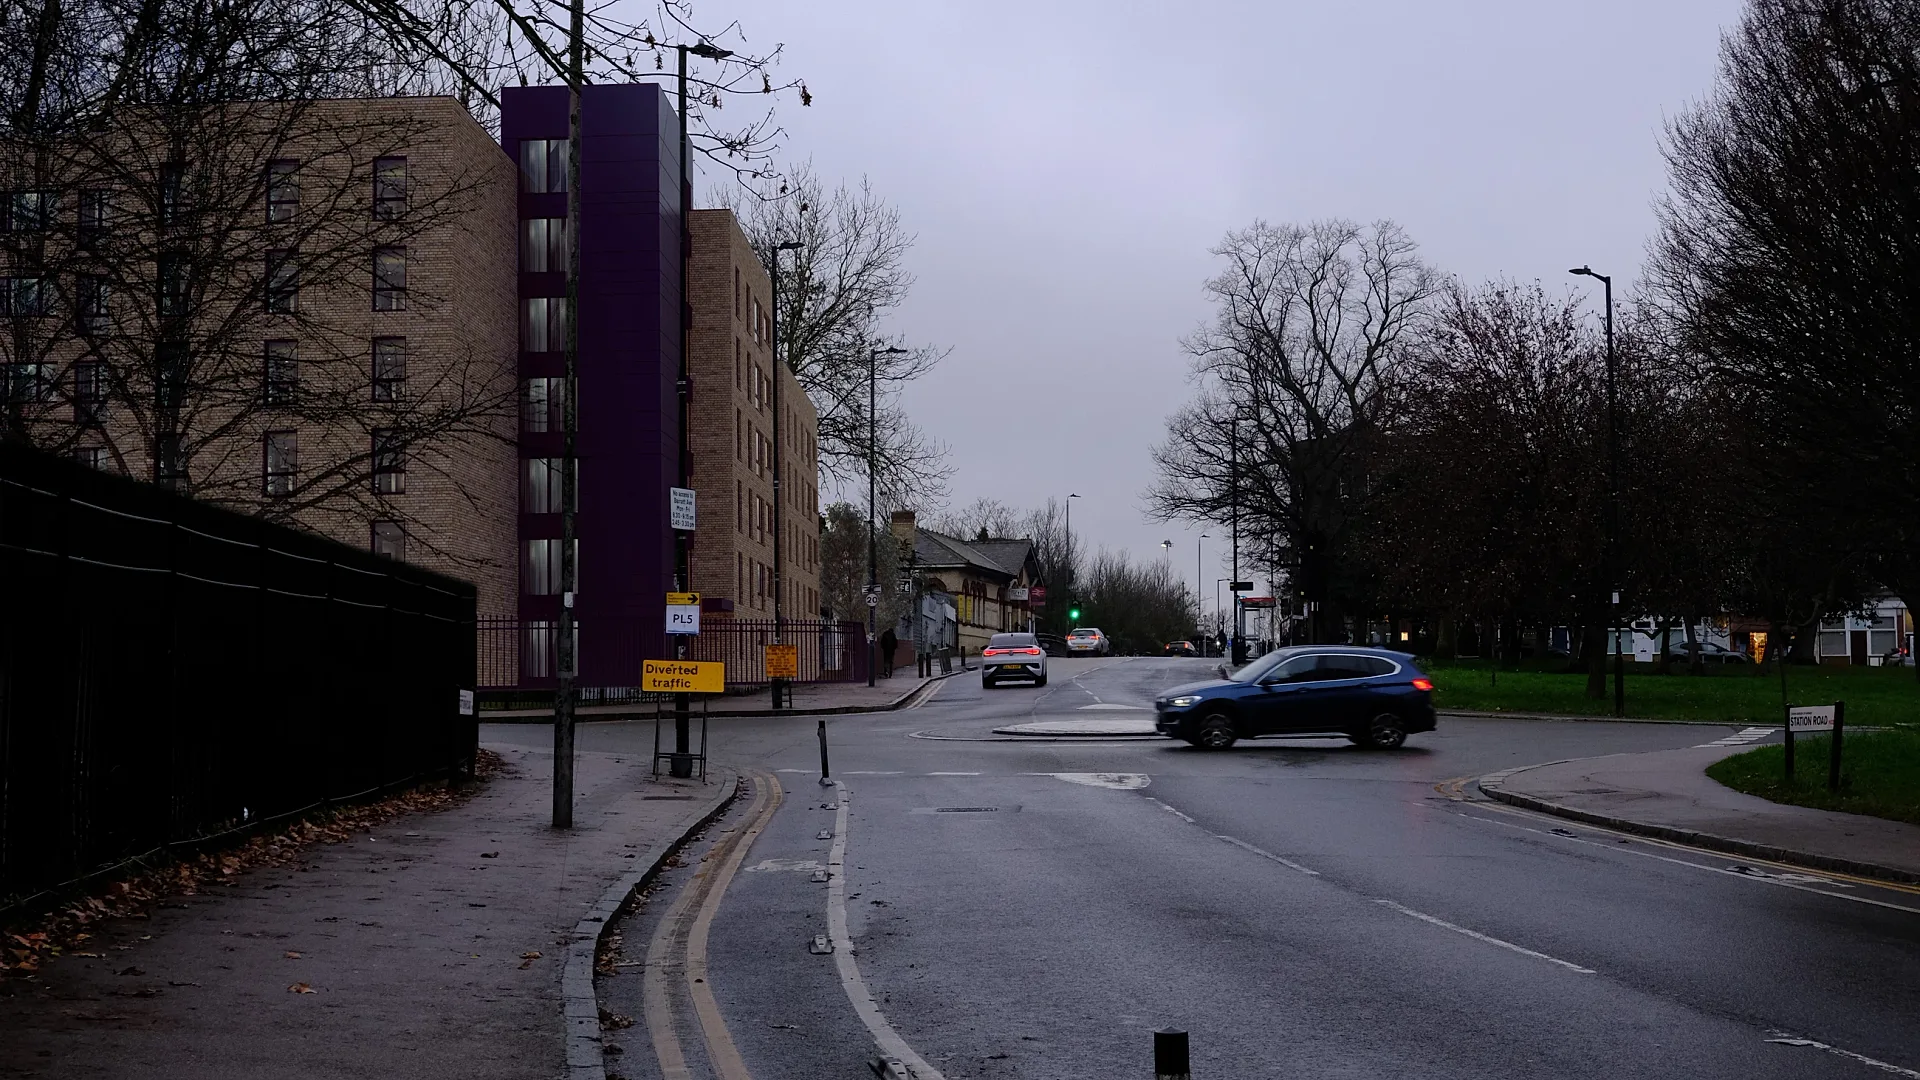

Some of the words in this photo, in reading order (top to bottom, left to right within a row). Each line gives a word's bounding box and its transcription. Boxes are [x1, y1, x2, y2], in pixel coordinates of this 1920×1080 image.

[866, 596, 878, 604] 20
[673, 614, 693, 624] PL5
[645, 664, 698, 675] Diverted
[652, 678, 691, 688] traffic
[1790, 716, 1811, 726] STATION
[1813, 715, 1828, 725] ROAD
